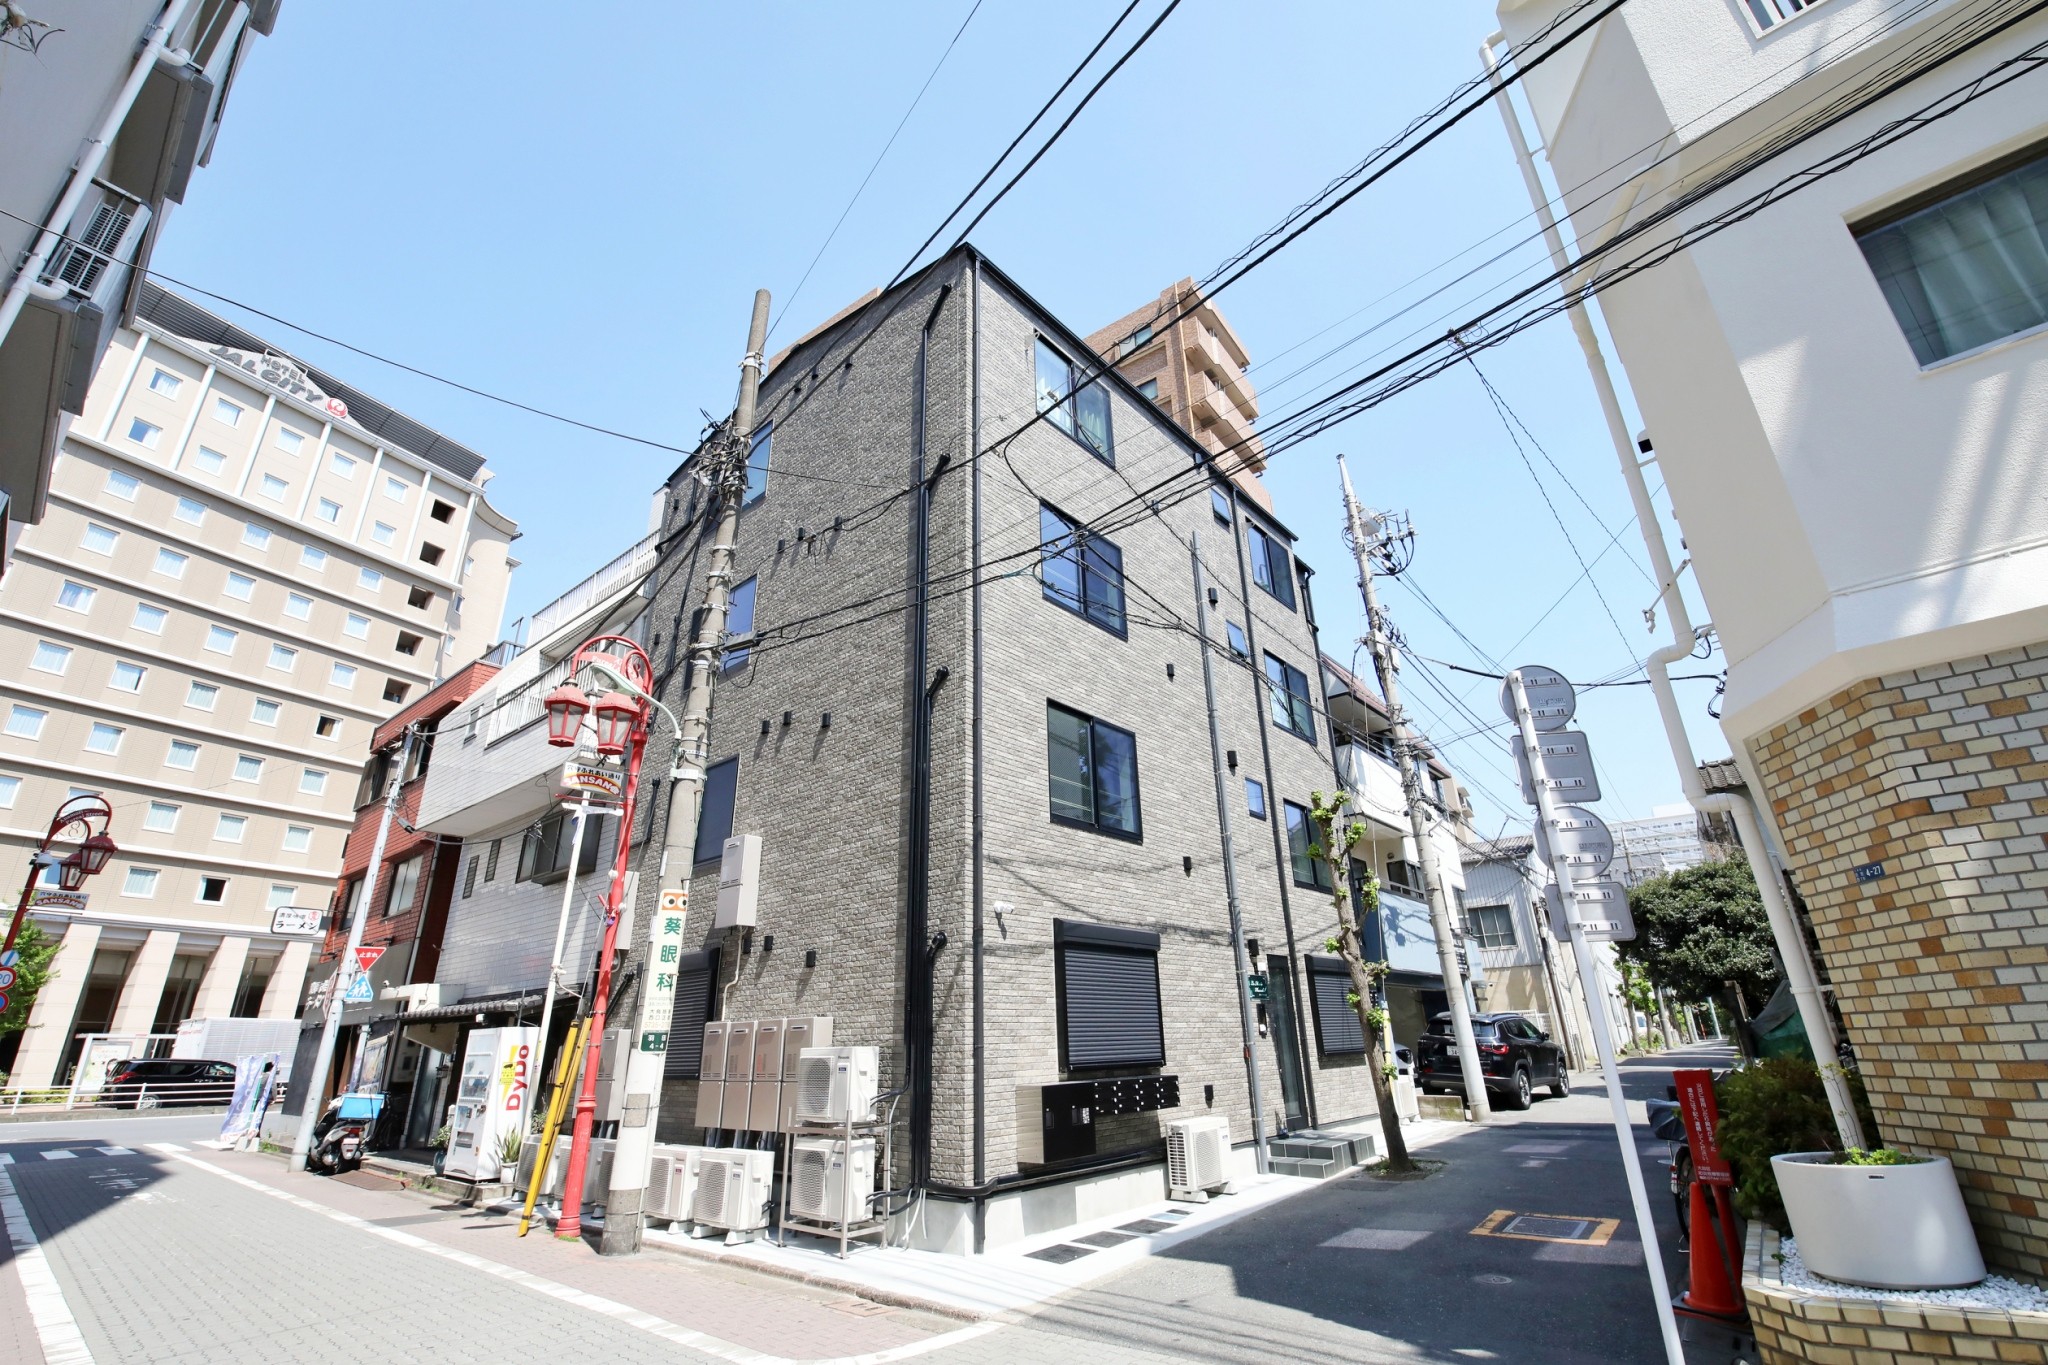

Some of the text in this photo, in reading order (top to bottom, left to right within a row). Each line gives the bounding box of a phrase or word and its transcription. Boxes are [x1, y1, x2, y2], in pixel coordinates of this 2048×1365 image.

[209, 346, 324, 403] JAL CITY
[261, 354, 305, 384] HOTEL
[275, 920, 317, 931] ラーメン
[359, 951, 379, 959] 止まれ
[656, 916, 682, 992] 葵眼科
[505, 1045, 530, 1111] DyDo
